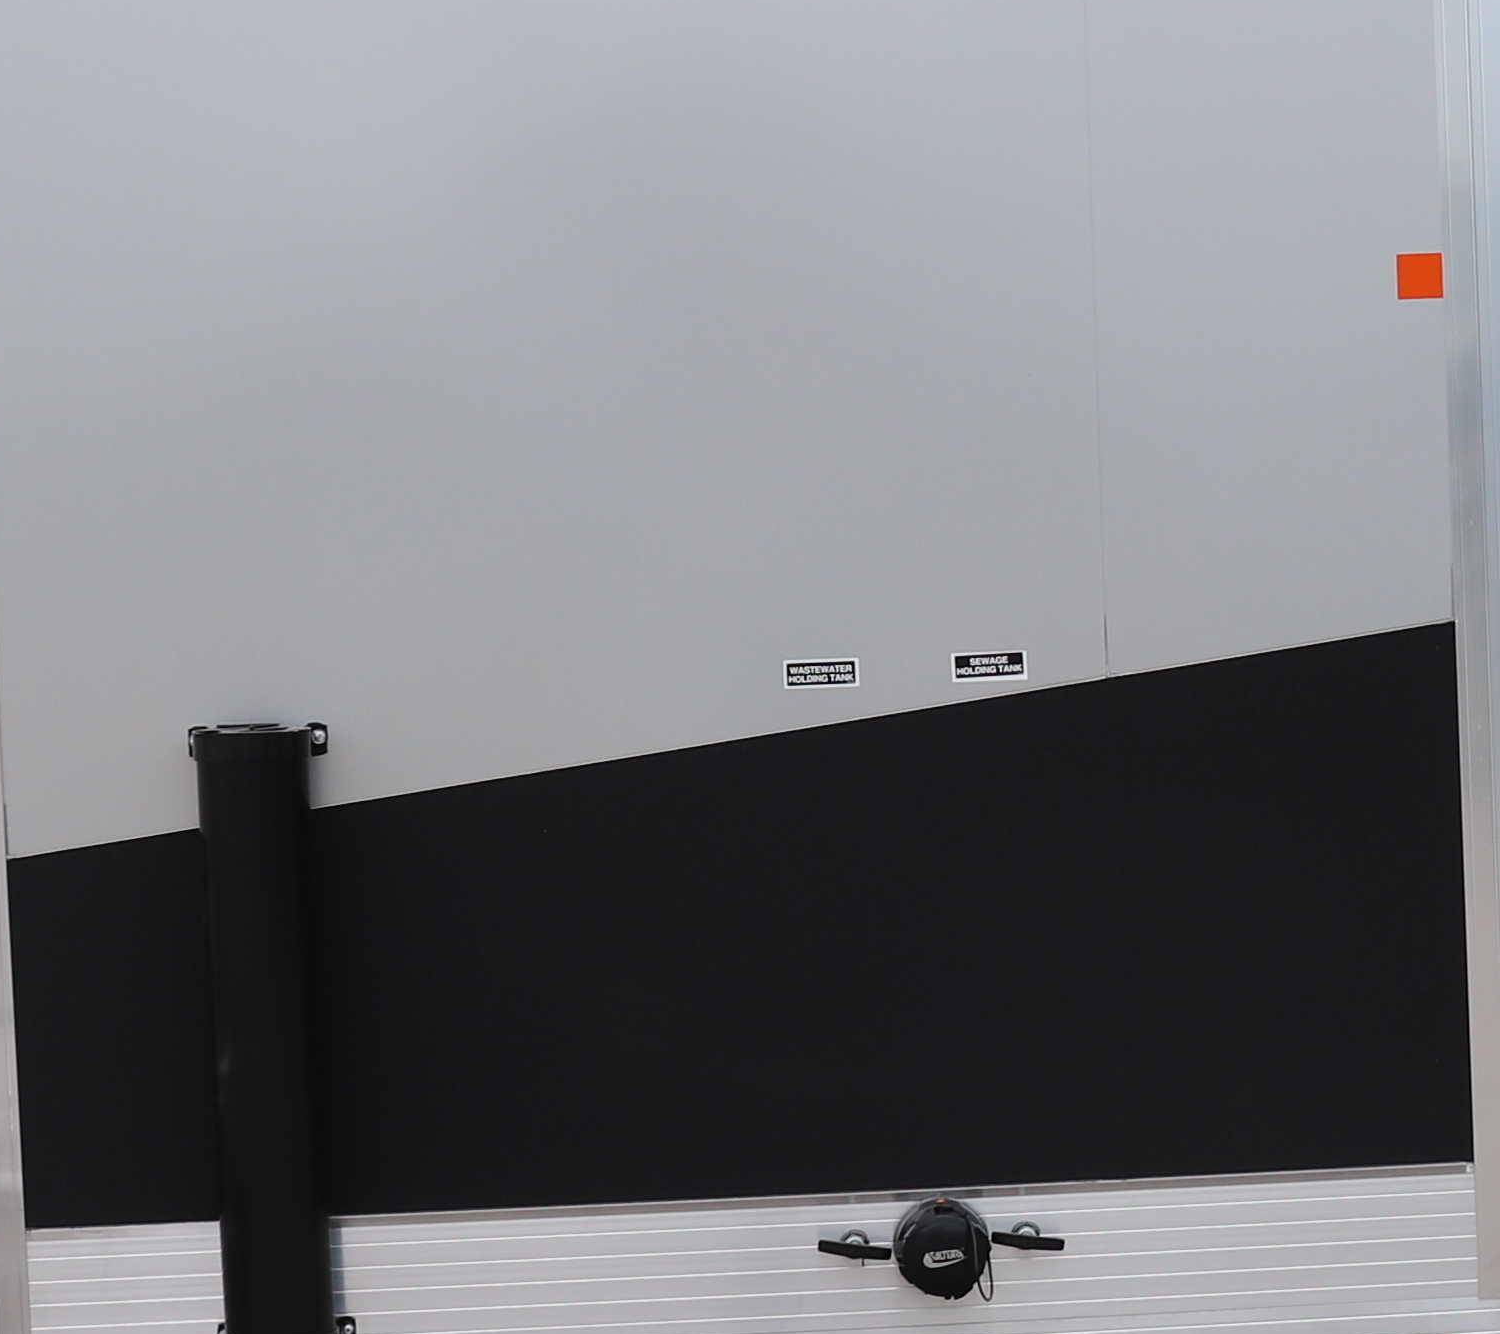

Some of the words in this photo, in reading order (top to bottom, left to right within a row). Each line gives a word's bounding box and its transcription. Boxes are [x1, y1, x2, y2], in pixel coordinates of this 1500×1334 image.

[969, 655, 1009, 666] SEWAGE
[789, 664, 853, 675] WASTEWATER
[956, 665, 997, 676] HOLDING
[998, 663, 1023, 673] TANK
[788, 674, 829, 684] HOLDING
[829, 673, 854, 682] TANK
